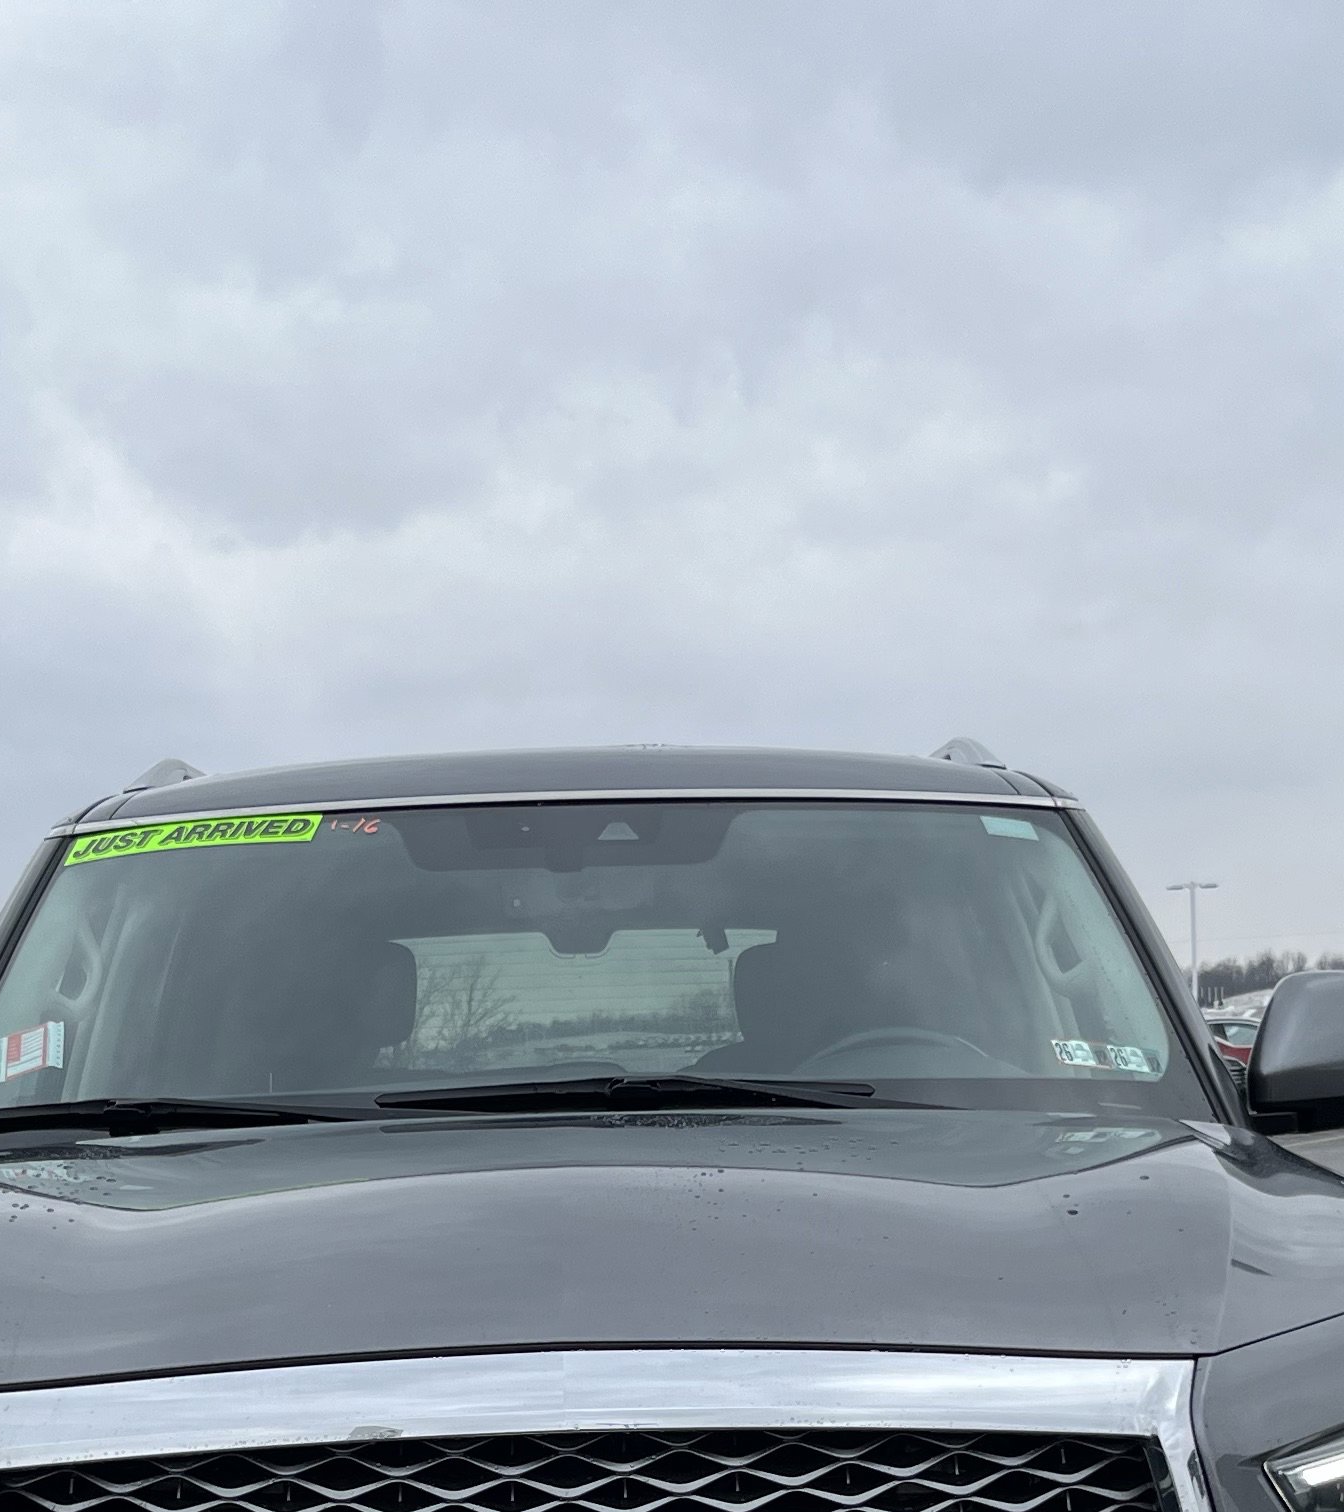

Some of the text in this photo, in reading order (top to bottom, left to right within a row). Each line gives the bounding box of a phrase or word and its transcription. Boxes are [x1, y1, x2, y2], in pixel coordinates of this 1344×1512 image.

[72, 816, 316, 859] JUST ARRIVED
[1055, 1042, 1074, 1062] 26
[1110, 1047, 1129, 1067] 26
